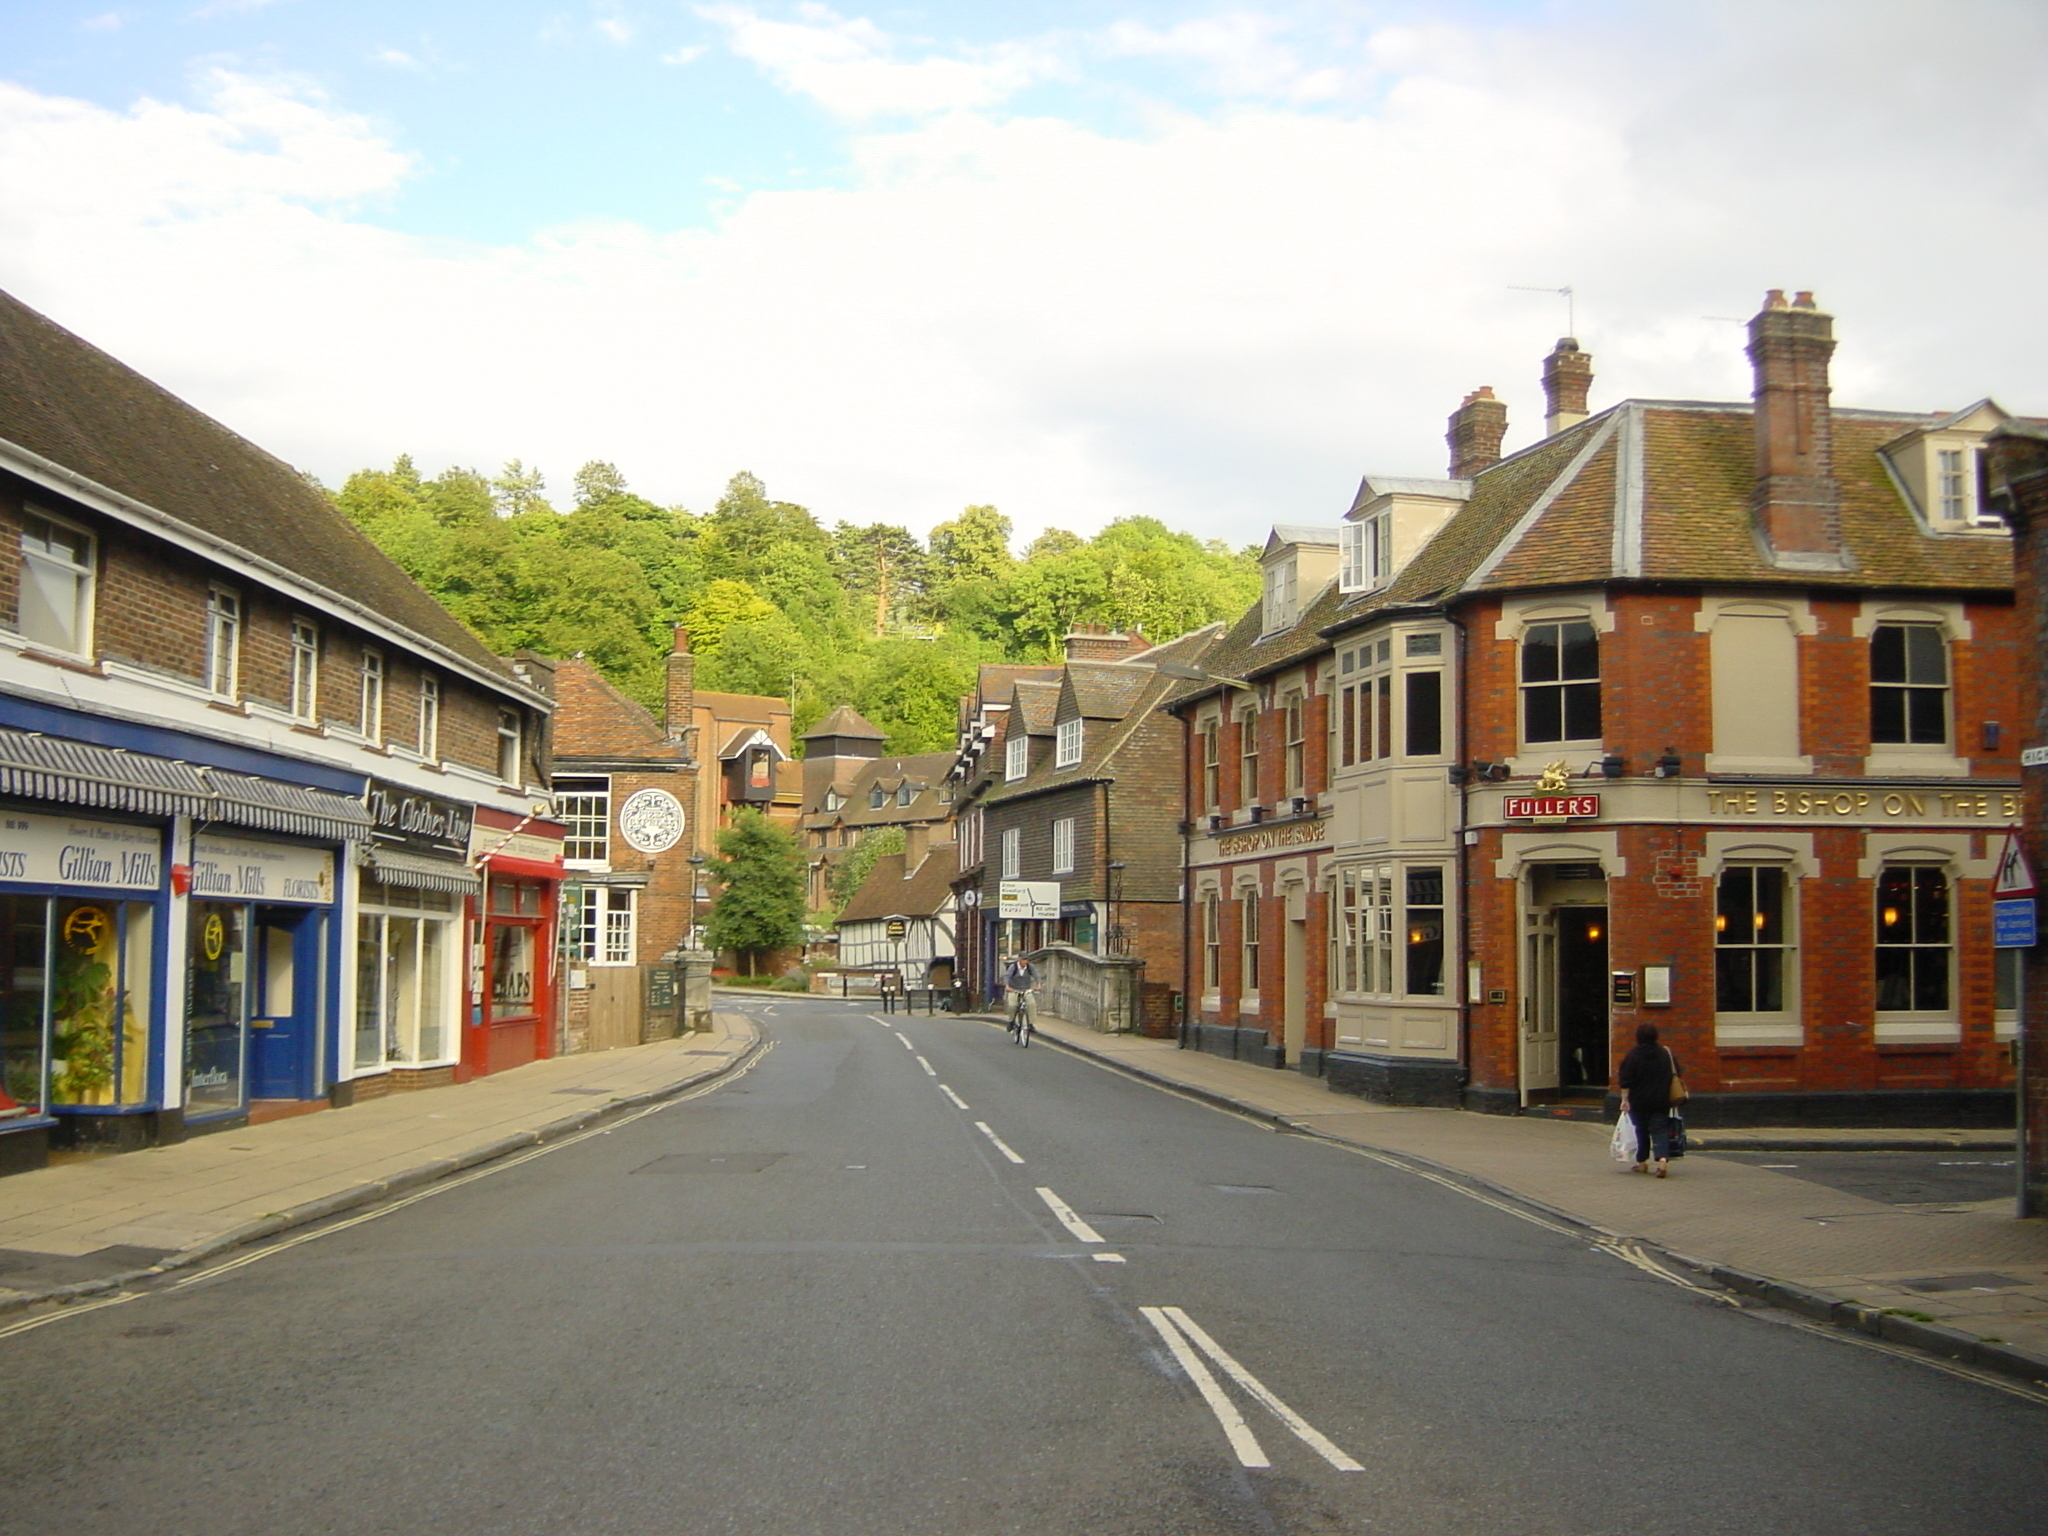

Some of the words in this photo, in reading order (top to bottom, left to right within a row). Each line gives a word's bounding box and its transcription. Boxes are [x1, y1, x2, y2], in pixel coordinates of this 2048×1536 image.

[371, 790, 398, 827] The
[400, 798, 446, 837] Clothes
[445, 809, 470, 842] Line
[1509, 797, 1592, 815] FULLER'S
[1707, 791, 1757, 814] THE
[1772, 791, 1869, 816] BISHOP
[1883, 793, 1926, 816] ON
[1939, 794, 1988, 817] THE
[1261, 831, 1275, 850] ON
[1278, 827, 1293, 847] THE
[59, 845, 112, 883] Gillian
[116, 850, 157, 886] Mills
[192, 860, 232, 893] Gillian
[235, 865, 265, 895] Mills
[283, 878, 319, 899] FLORISTS
